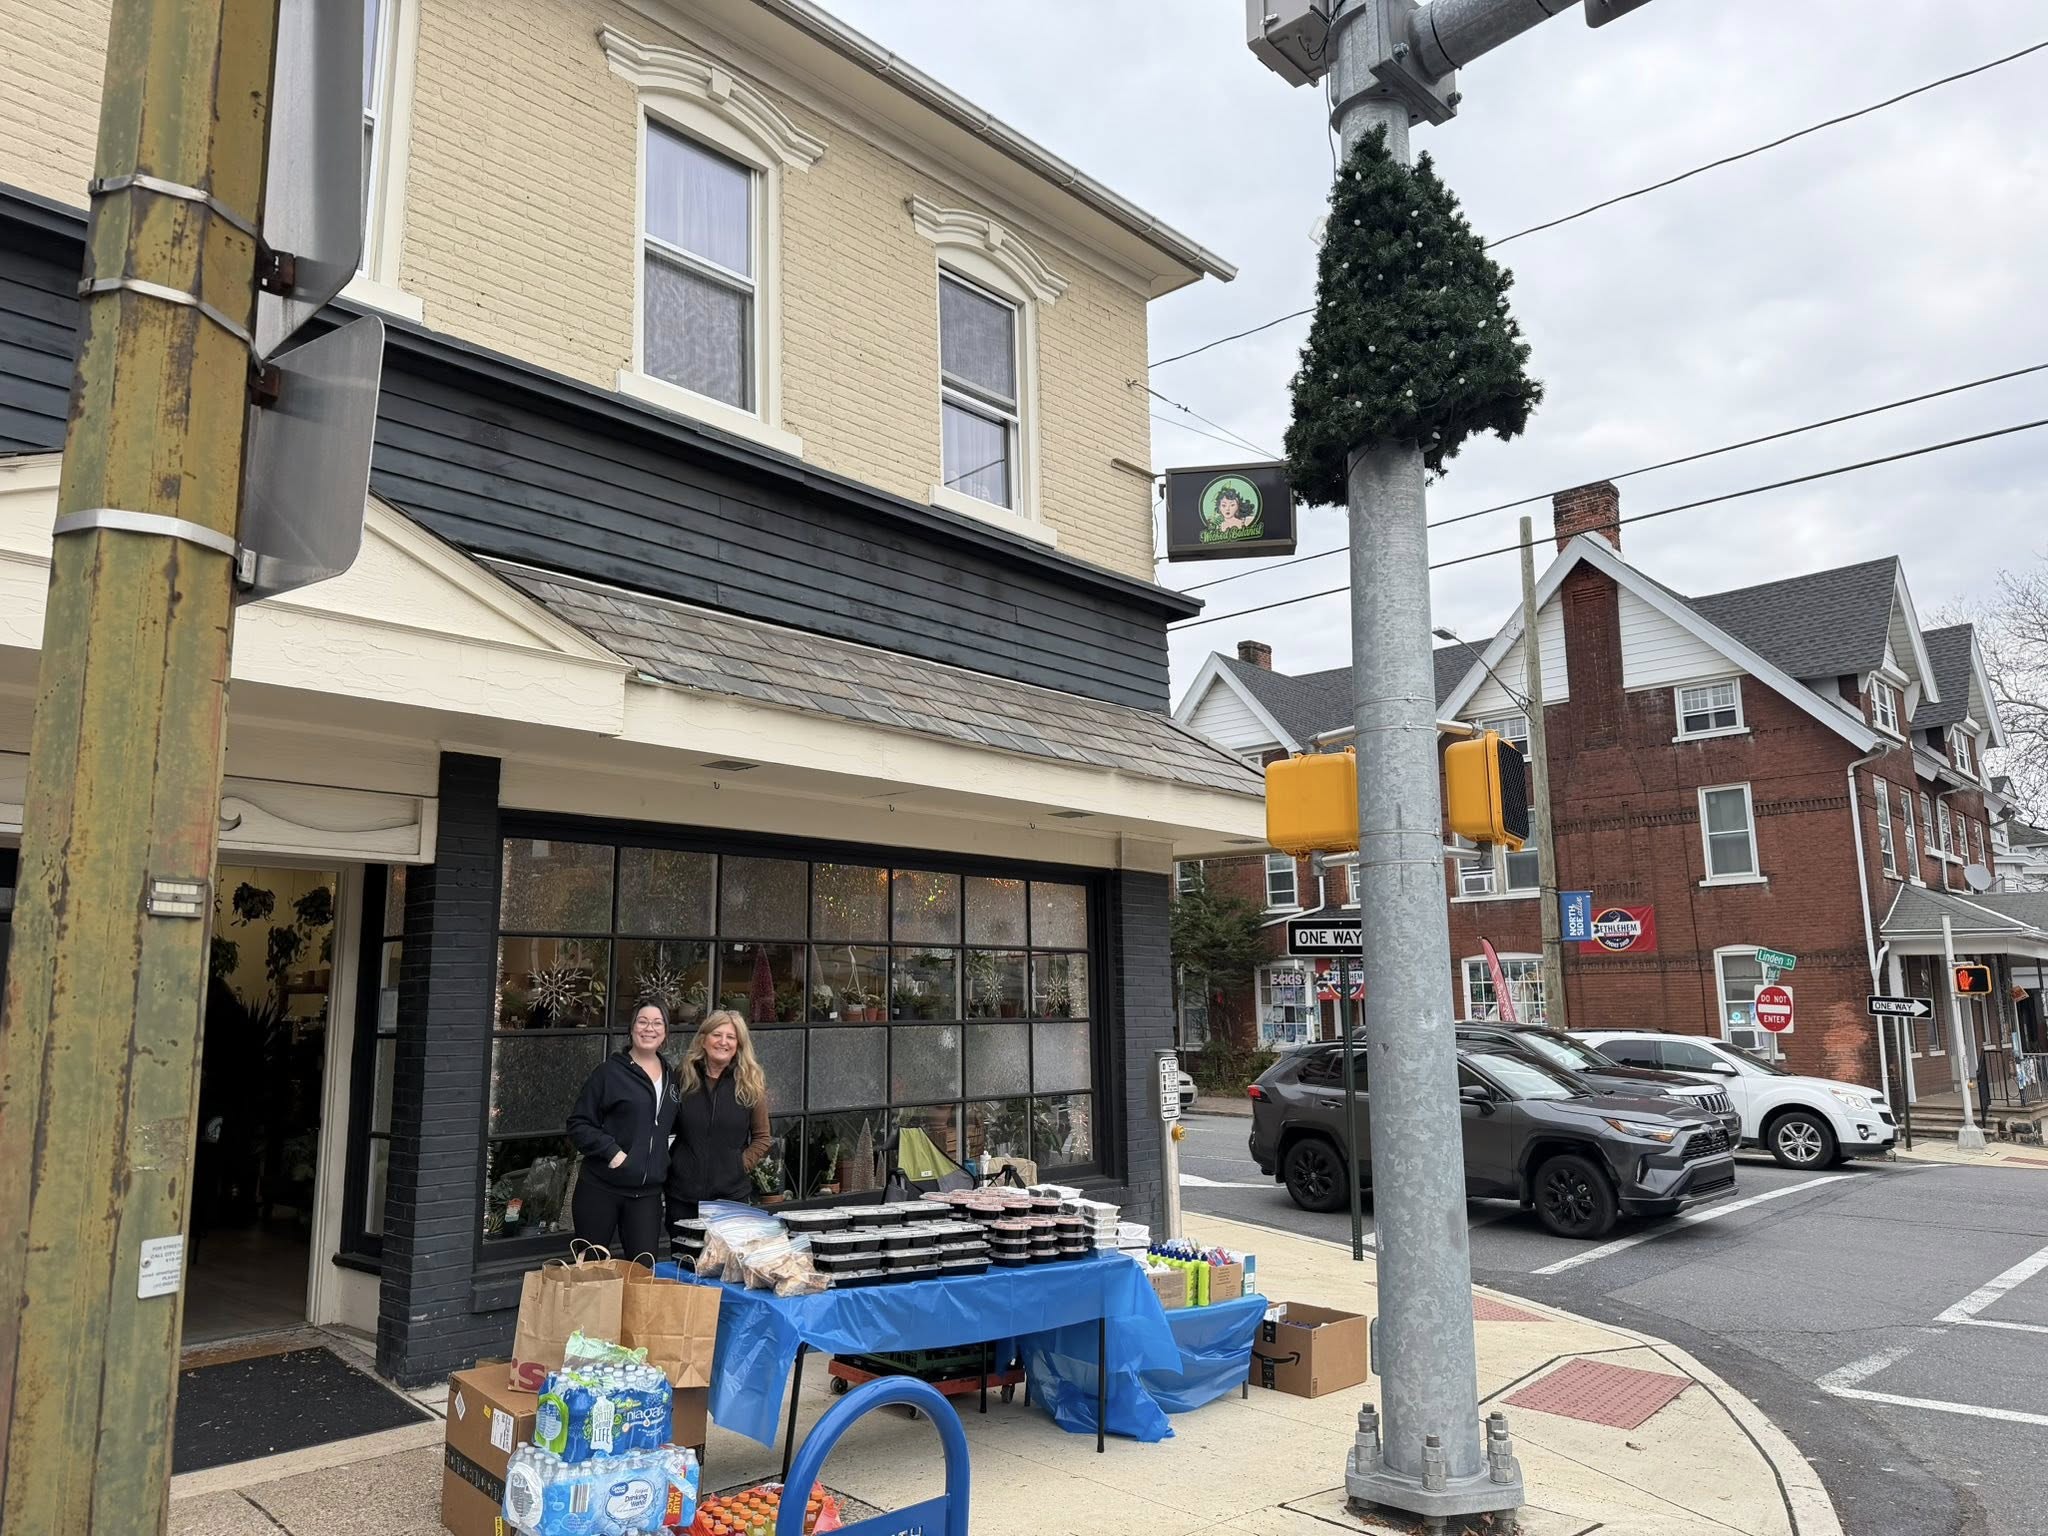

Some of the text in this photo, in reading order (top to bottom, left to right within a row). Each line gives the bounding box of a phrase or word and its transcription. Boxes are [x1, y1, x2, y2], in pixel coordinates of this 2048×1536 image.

[1569, 905, 1577, 936] NORTH
[1300, 931, 1362, 944] ONE WAY
[1759, 950, 1783, 966] Linden
[1271, 974, 1302, 985] E-CIGS
[1895, 1003, 1912, 1011] WAY
[1764, 1015, 1785, 1023] ENTER
[594, 1427, 611, 1444] LIFE
[624, 1493, 648, 1503] Drinking
[667, 1492, 675, 1515] PACK
[672, 1491, 682, 1515] VALUE
